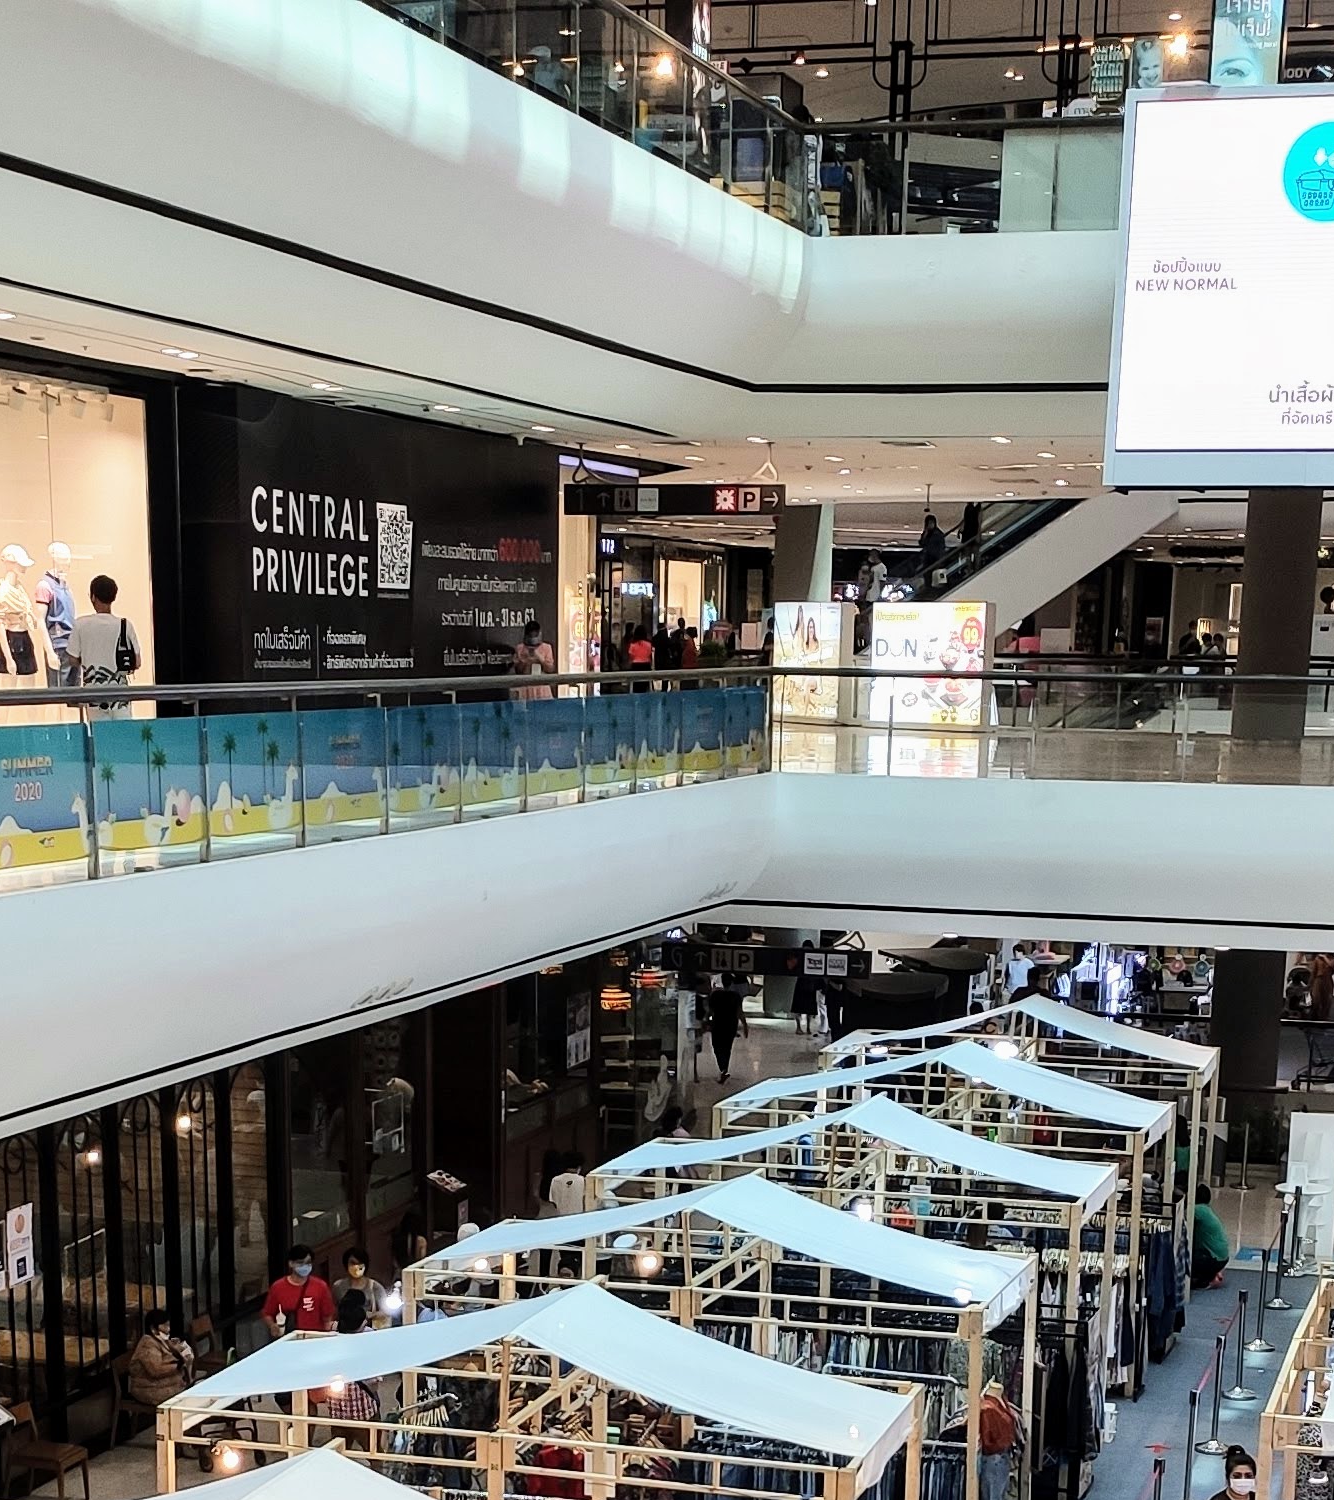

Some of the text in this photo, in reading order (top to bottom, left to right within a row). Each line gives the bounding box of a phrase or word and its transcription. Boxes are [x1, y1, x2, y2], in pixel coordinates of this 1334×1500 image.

[1284, 67, 1312, 80] ODY
[1153, 257, 1221, 273] ช้อปปิ้งแบบ
[1135, 278, 1238, 291] NEW NORMAL
[743, 492, 756, 509] P
[251, 486, 369, 541] CENTRAL
[252, 547, 369, 597] PRIVILEGE
[0, 756, 53, 778] SUMMER
[14, 781, 44, 802] 2020
